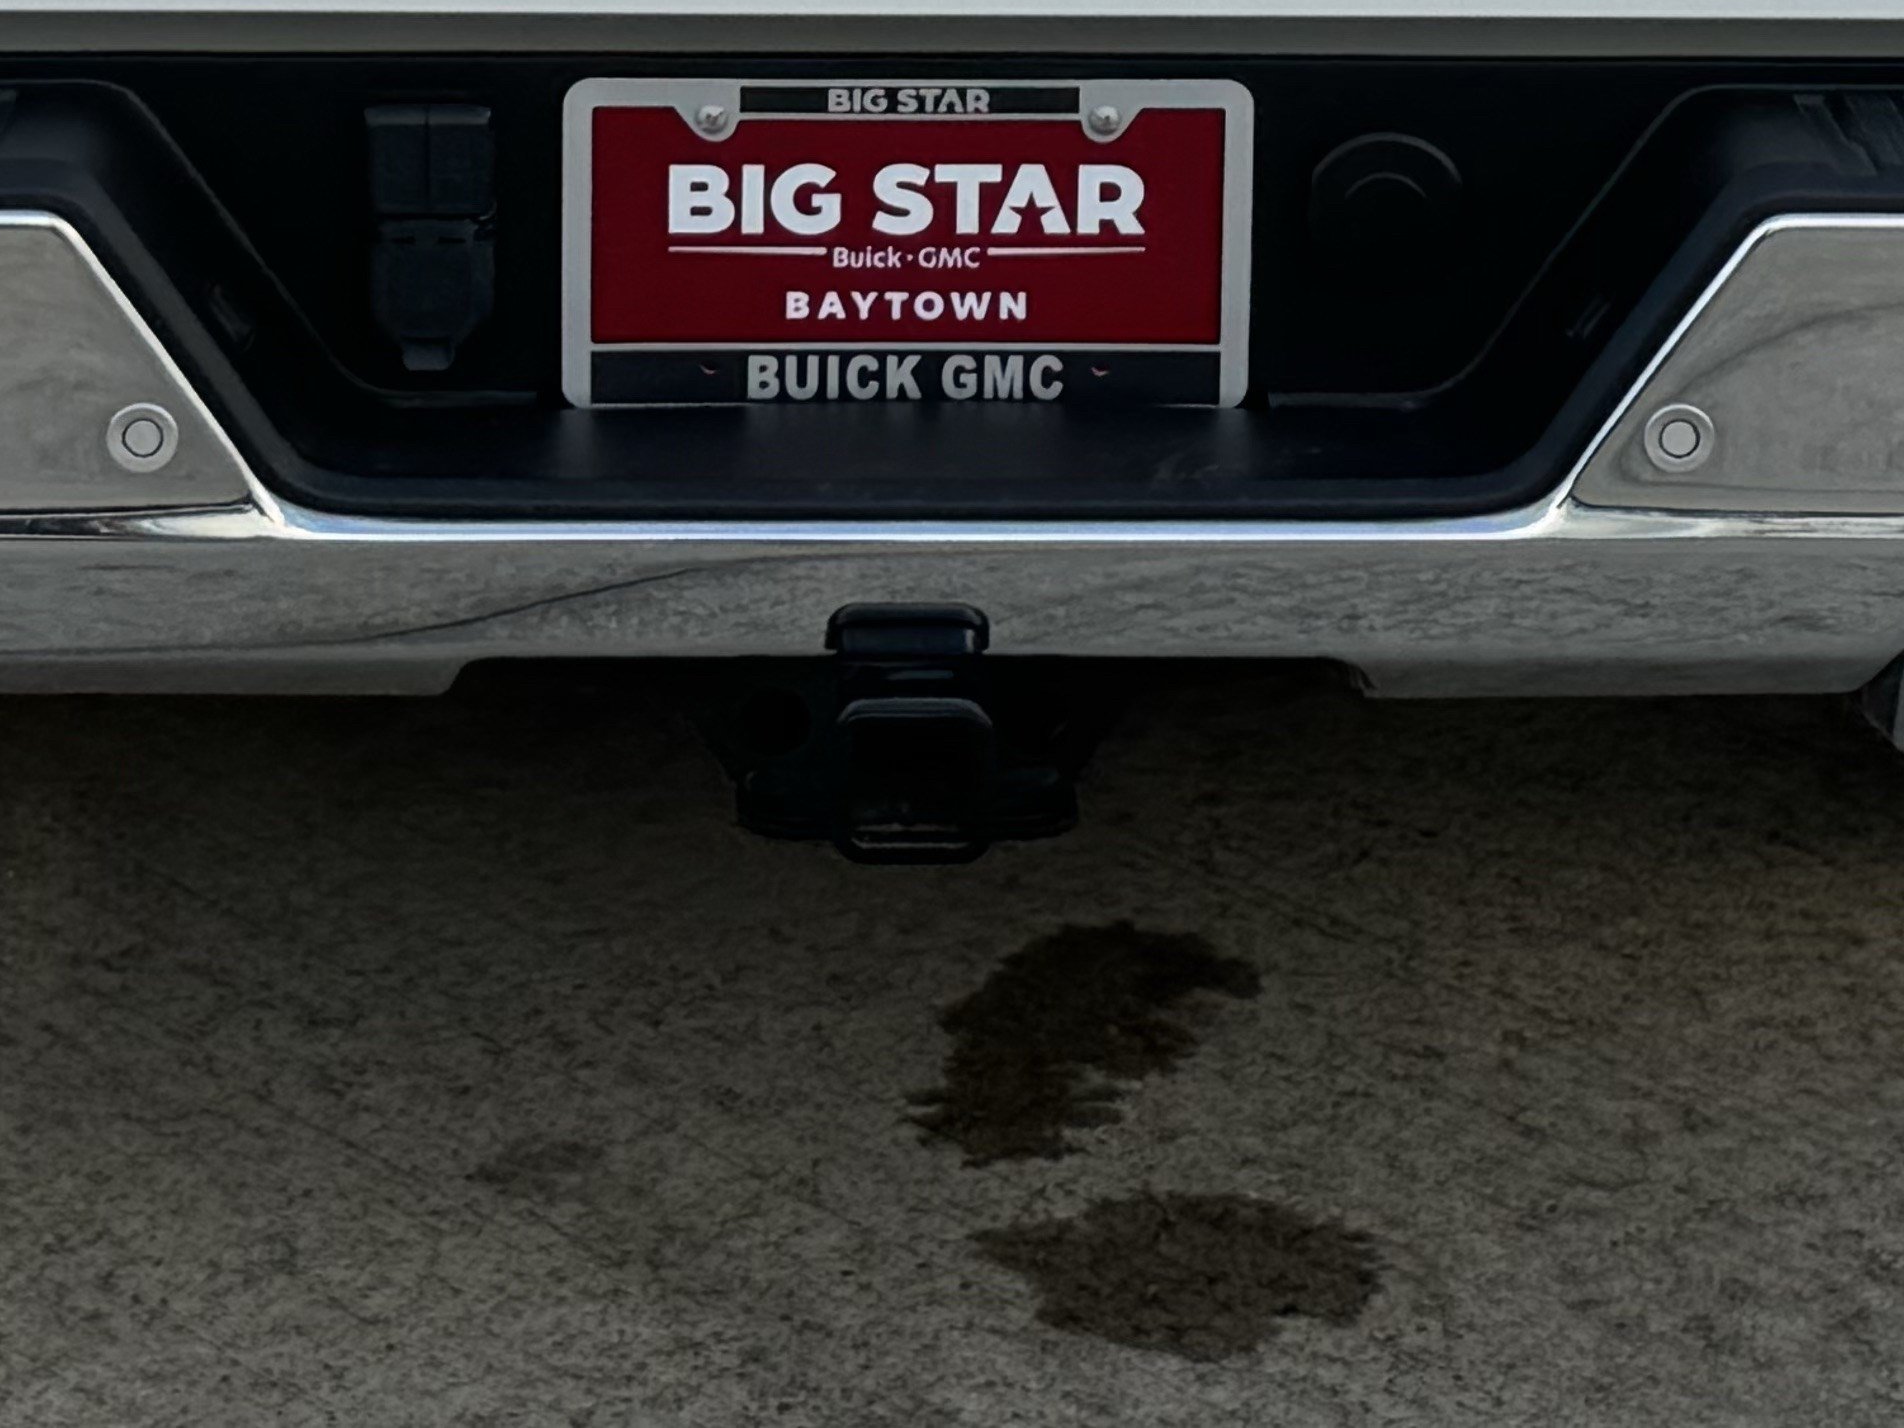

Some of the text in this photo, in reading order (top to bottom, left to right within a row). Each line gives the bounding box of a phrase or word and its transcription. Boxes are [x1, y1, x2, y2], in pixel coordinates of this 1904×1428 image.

[827, 88, 990, 114] BIG STAR
[668, 163, 1145, 236] BIG STAR
[832, 247, 981, 270] Buick GMC
[785, 291, 1028, 321] BAYTOWN
[746, 355, 1065, 401] BUICK GMC
